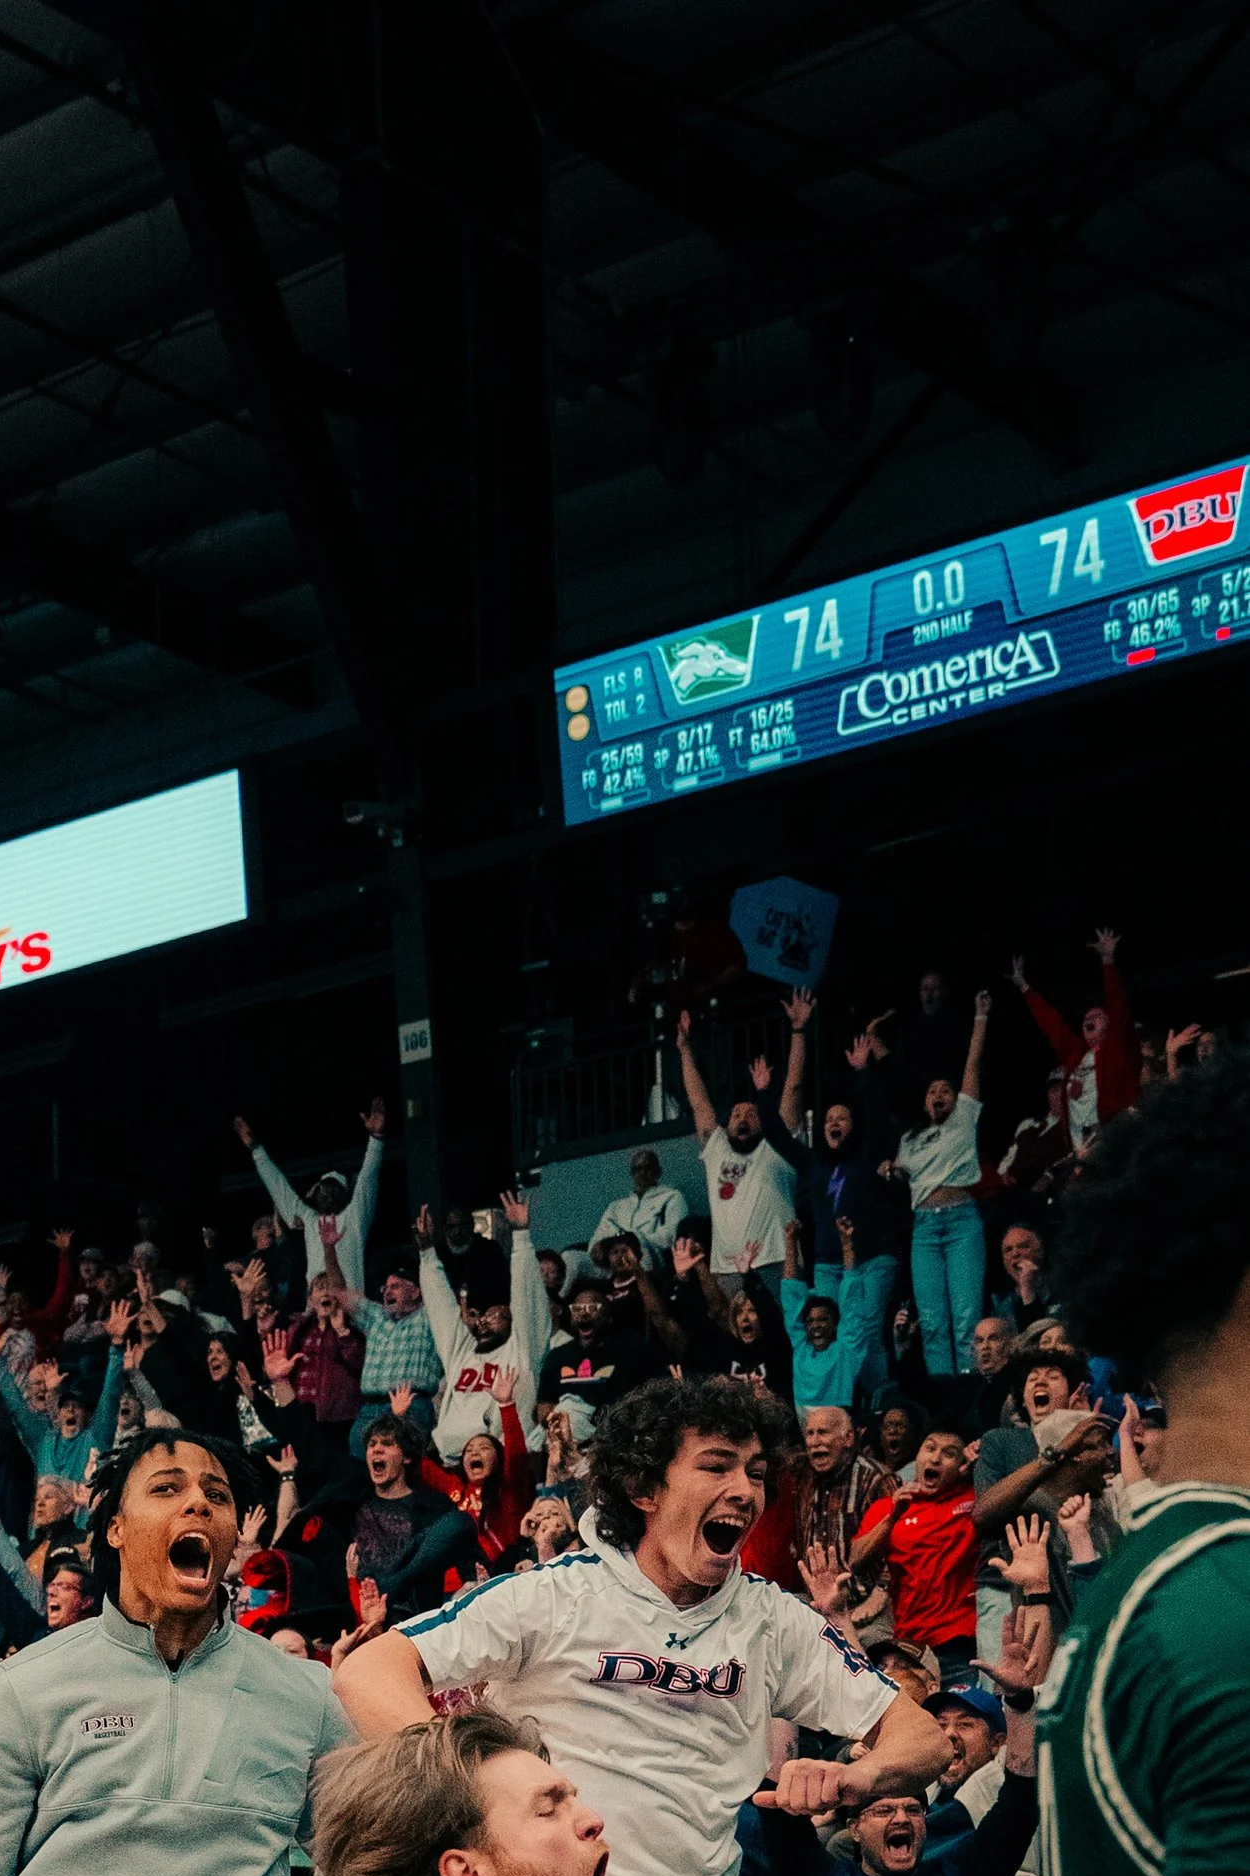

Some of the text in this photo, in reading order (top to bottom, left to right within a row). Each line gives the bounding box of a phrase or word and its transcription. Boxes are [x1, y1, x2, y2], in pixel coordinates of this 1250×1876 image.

[1144, 491, 1239, 542] DBU
[1040, 518, 1105, 597] 74
[912, 560, 966, 615] 0.0
[1127, 587, 1179, 623] 30/65
[1190, 593, 1211, 618] 3P
[783, 598, 843, 673] 74
[912, 609, 974, 646] 2ND HALF
[1103, 618, 1122, 642] FG
[1129, 614, 1182, 647] 46.2%
[603, 666, 644, 697] FLS 8
[604, 694, 646, 725] TOL 2
[750, 699, 795, 730] 16/25
[892, 682, 1007, 727] CENTER
[677, 722, 714, 752] 8/17
[728, 727, 744, 748] FT
[750, 725, 797, 754] 64.0%
[601, 743, 645, 773] 25/59
[653, 749, 670, 770] 3P
[676, 744, 721, 775] 47.1%
[582, 769, 598, 791] FG
[603, 767, 647, 796] 42.4%
[591, 1652, 746, 1699] DBU
[81, 1715, 135, 1734] DBU
